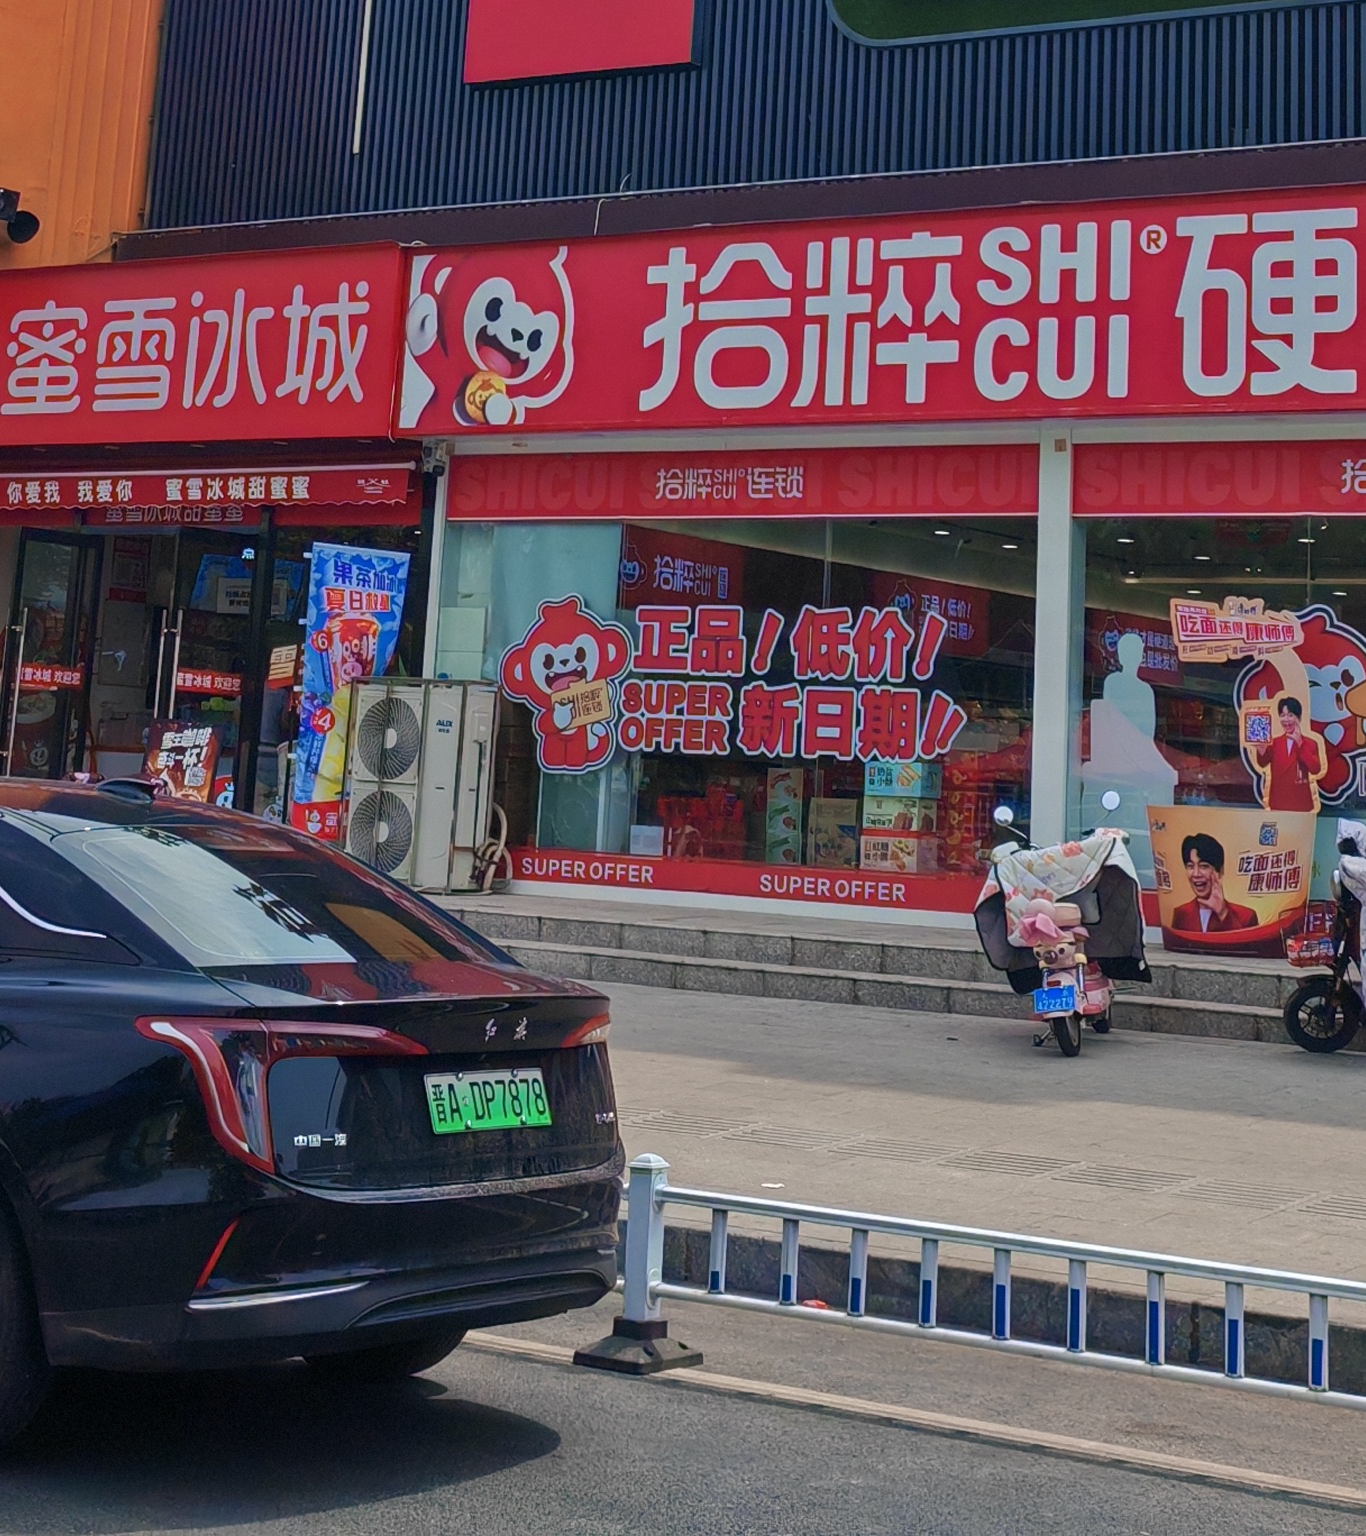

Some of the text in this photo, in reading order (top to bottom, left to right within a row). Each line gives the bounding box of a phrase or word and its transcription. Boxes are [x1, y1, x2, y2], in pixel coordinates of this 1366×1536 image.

[976, 219, 1131, 307] SHI
[639, 231, 961, 412] 拾粹
[0, 280, 371, 416] 蜜雪冰城
[974, 314, 1129, 402] CUI
[6, 476, 311, 505] 你爱我 我爱你 蜜雪冰城甜蜜蜜
[655, 466, 712, 500] 拾粹
[746, 465, 803, 499] 连锁
[621, 680, 734, 719] SUPER
[619, 714, 731, 755] OFFER
[521, 857, 654, 884] SUPER OFFER
[759, 874, 906, 902] SUPER OFFER
[293, 1132, 347, 1148] 中国一汽
